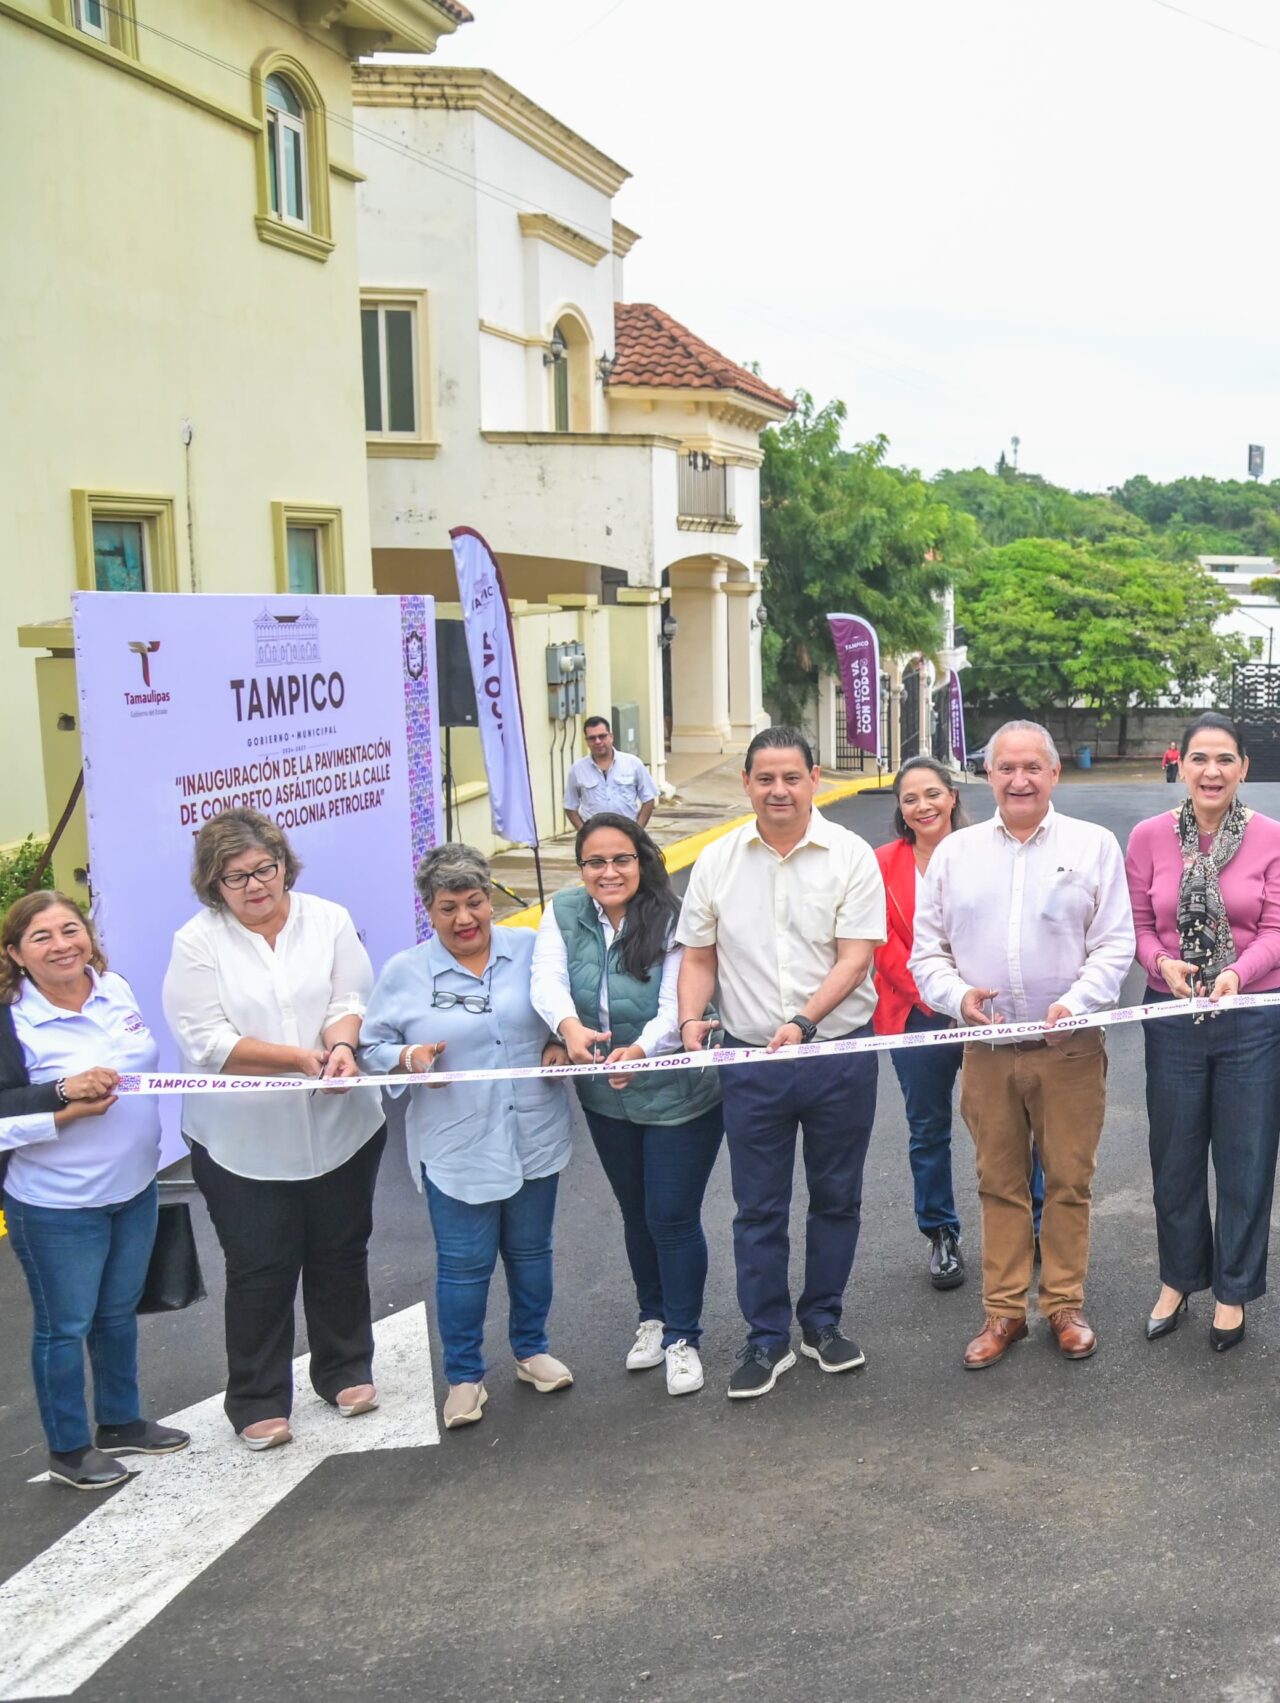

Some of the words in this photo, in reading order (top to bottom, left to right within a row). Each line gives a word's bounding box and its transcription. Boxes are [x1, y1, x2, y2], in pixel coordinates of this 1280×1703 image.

[845, 640, 869, 651] TAMPICO
[851, 659, 859, 679] VA
[230, 671, 345, 722] TAMPICO
[860, 666, 870, 702] TODO
[124, 689, 171, 705] Tamaulipas
[853, 679, 862, 735] TAMPICO
[861, 705, 871, 733] CON
[247, 733, 290, 748] GOBIERNO
[296, 725, 337, 740] MUNICIPAL
[283, 757, 297, 778] DE
[300, 754, 313, 774] LA
[315, 736, 391, 771] PAVIMENTACIÓN
[180, 802, 198, 826] DE
[201, 788, 272, 820] CONCRETO
[275, 777, 332, 805] ASFÁLTICO
[334, 772, 347, 792] DE
[349, 770, 361, 788] LA
[363, 764, 391, 785] CALLE
[276, 802, 327, 830] COLONIA
[932, 1029, 993, 1041] TAMPICO
[540, 1066, 598, 1074] TAMPICO
[621, 1062, 650, 1070] CON
[655, 1057, 691, 1067] TODO
[148, 1079, 207, 1089] TAMPICO
[212, 1080, 226, 1088] VA
[231, 1080, 261, 1088] CON
